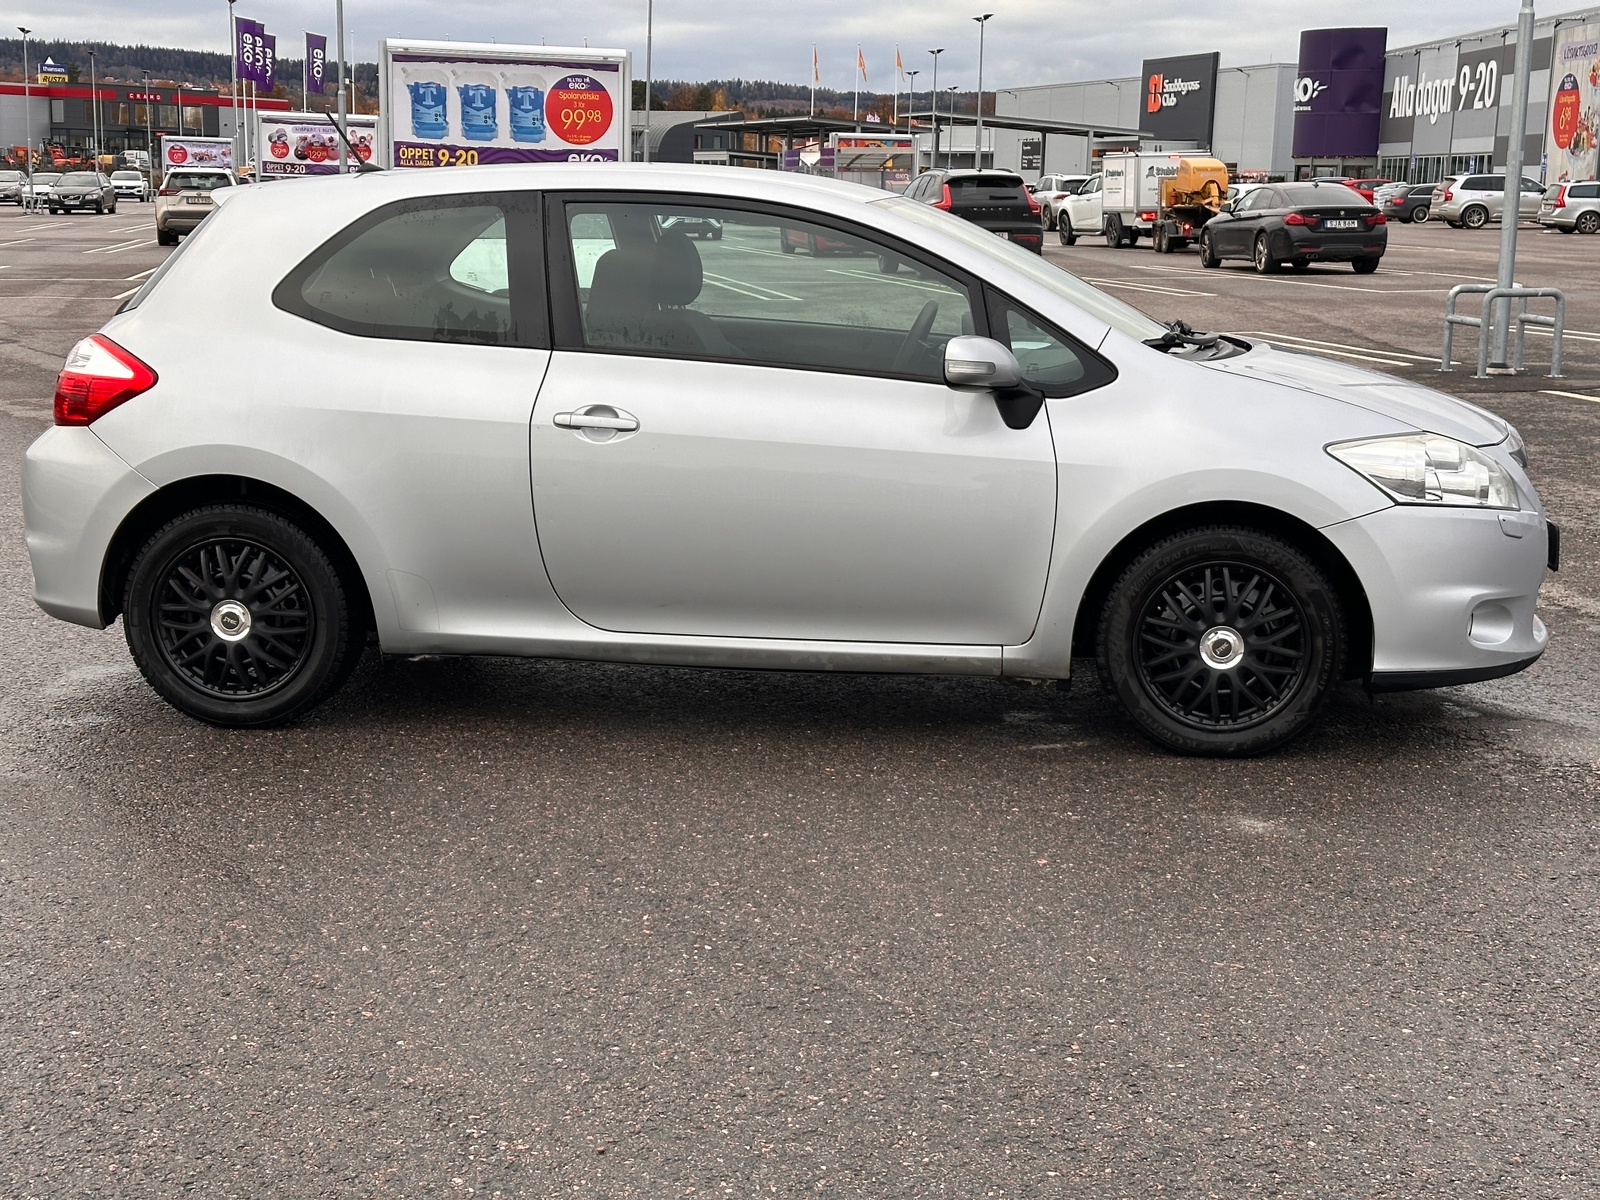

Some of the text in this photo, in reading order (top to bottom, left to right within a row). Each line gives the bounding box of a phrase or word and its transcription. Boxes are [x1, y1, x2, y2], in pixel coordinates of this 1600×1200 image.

[1164, 78, 1200, 95] Snabbgross
[1389, 60, 1497, 124] Alla dagar 9-20
[559, 92, 600, 100] Spolarvätska
[1162, 93, 1177, 106] Club
[400, 145, 478, 166] ÖPPET 9-20
[286, 164, 306, 174] 9-20
[1134, 708, 1198, 748] KUMHO
